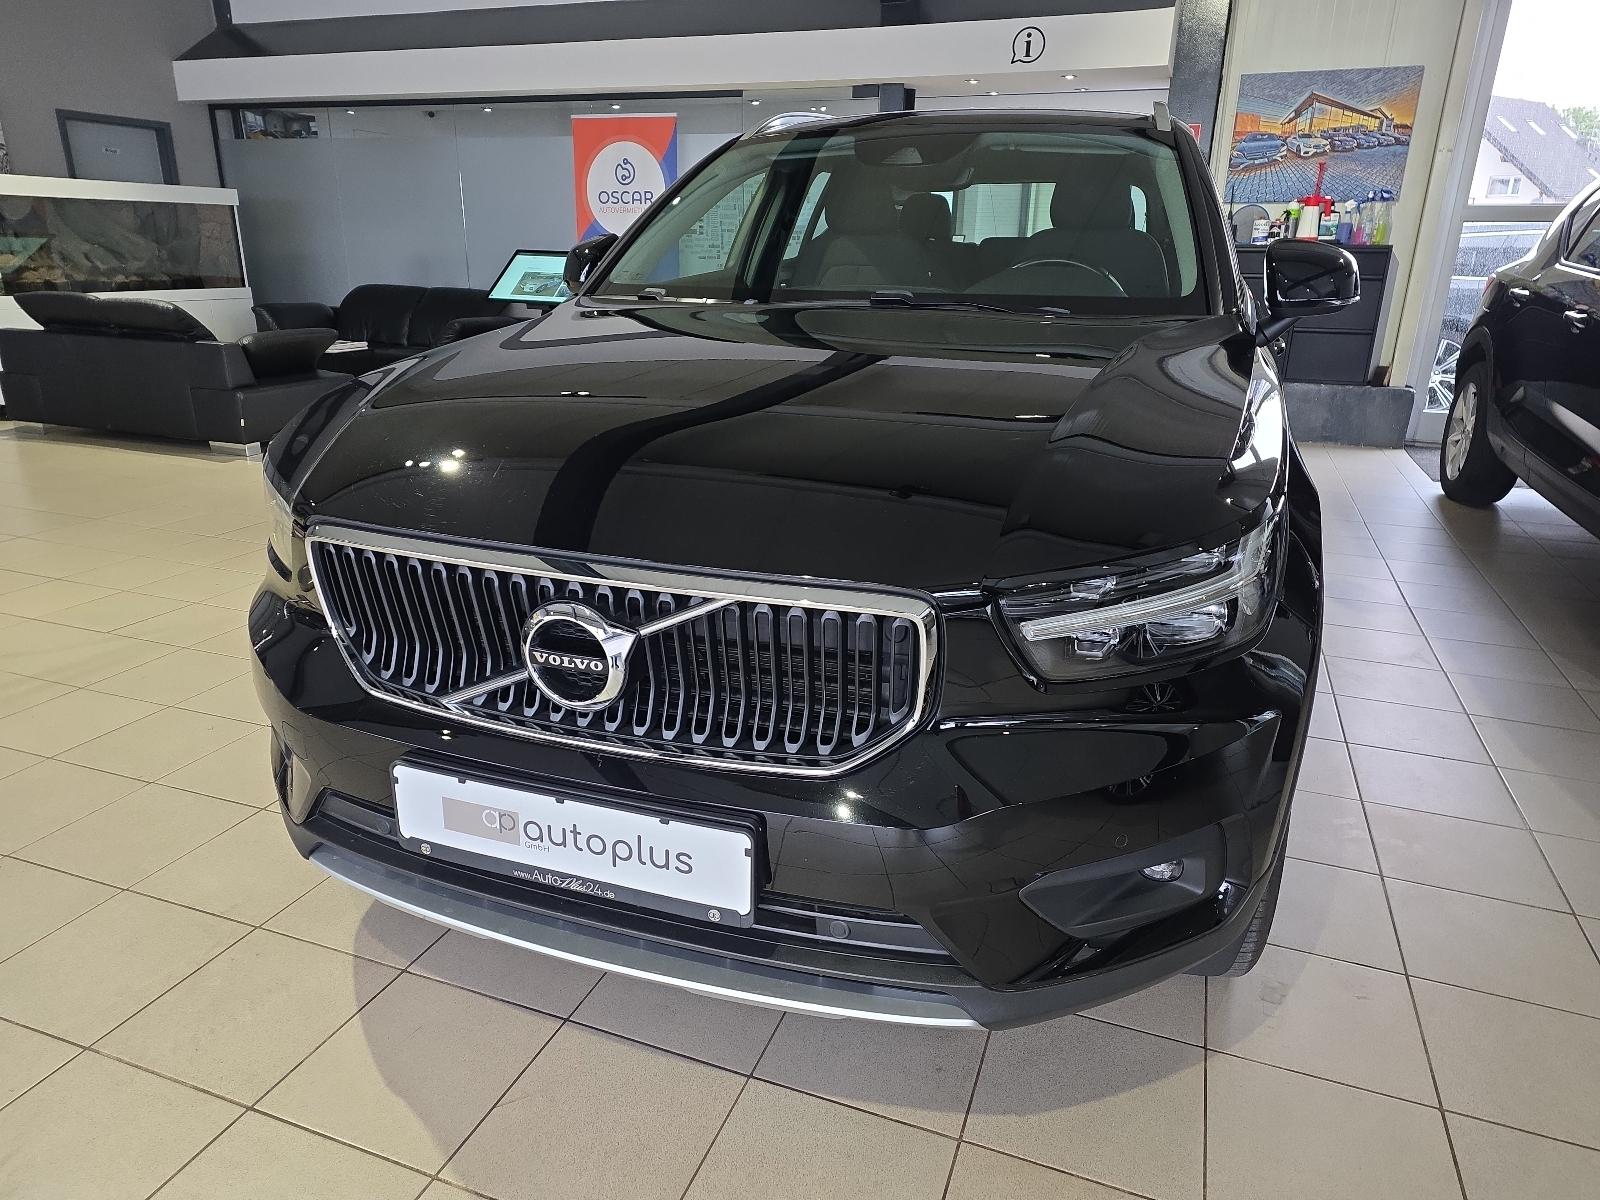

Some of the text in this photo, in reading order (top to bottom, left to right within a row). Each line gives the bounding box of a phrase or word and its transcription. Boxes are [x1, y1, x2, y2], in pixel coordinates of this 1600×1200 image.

[598, 191, 653, 204] OSCAR
[532, 651, 604, 671] VOLVO
[523, 820, 693, 874] autoplus
[525, 841, 550, 852] GmbH
